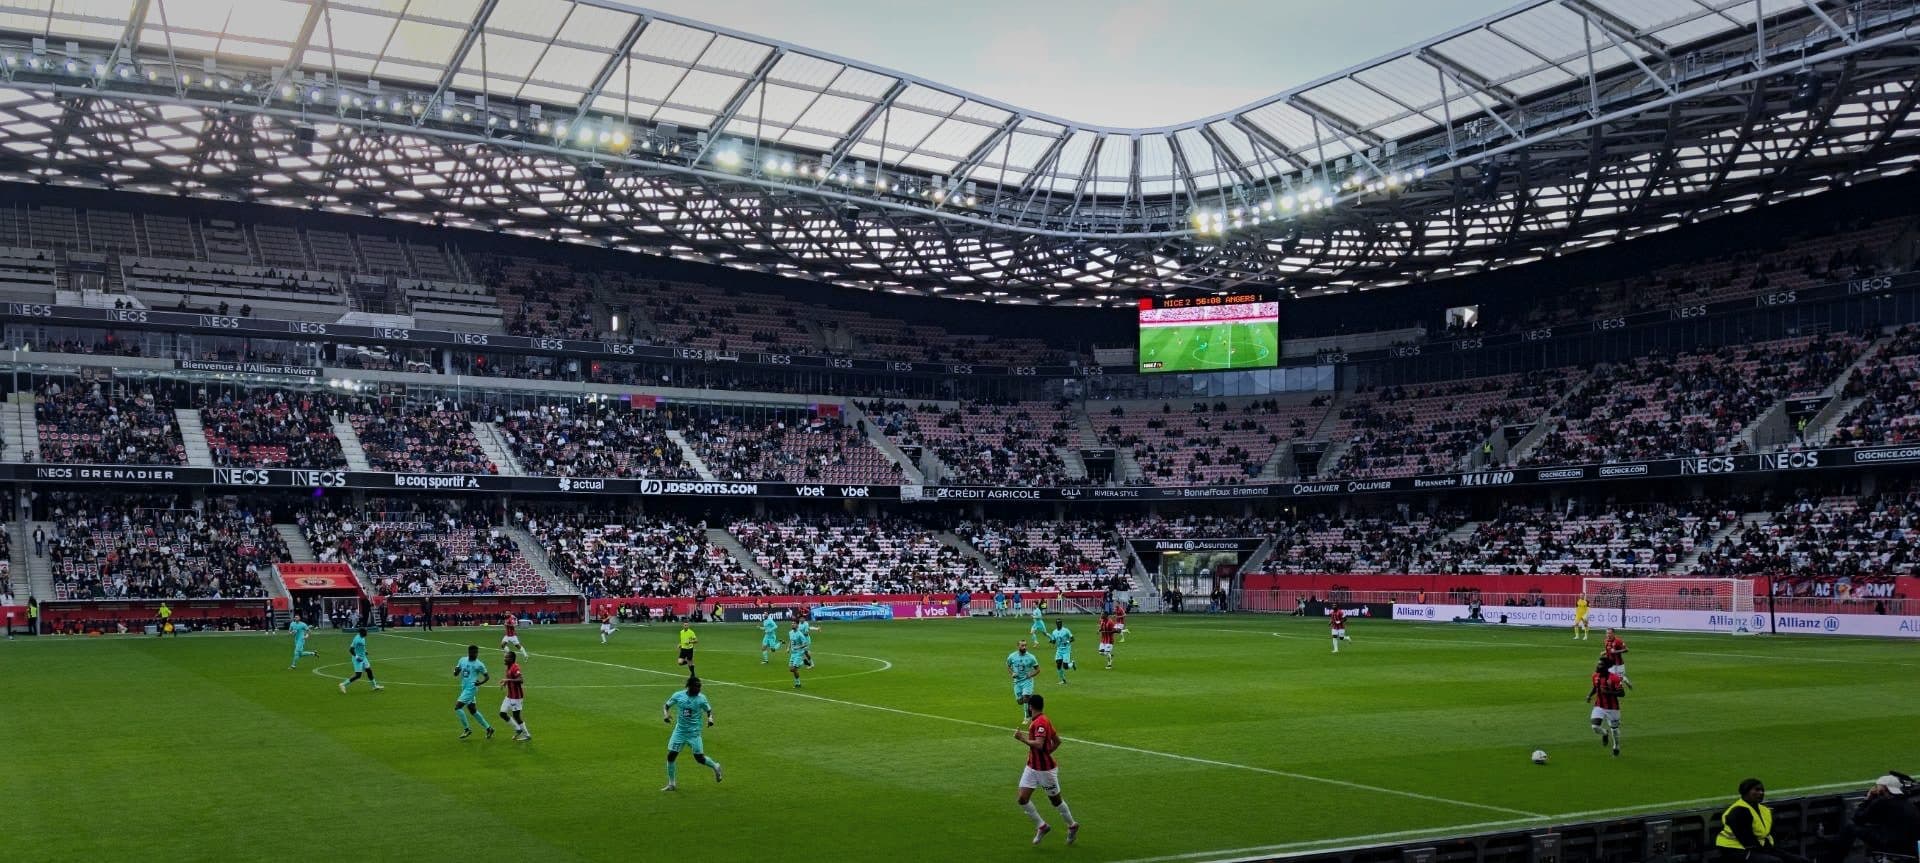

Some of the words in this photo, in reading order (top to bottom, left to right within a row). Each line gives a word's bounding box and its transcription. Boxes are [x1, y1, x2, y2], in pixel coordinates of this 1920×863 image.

[1849, 277, 1892, 294] INEOS
[1196, 297, 1221, 305] 56:08
[1225, 294, 1256, 303] ANGERS
[1756, 291, 1796, 307] INEOS
[9, 303, 52, 317] INEOS
[106, 309, 147, 323] INEOS
[1670, 305, 1706, 320] INEOS
[200, 315, 239, 329] INEOS
[288, 321, 326, 335] INEOS
[373, 327, 409, 340] INEOS
[454, 333, 488, 345] INEOS
[530, 337, 563, 350] INEOS
[603, 343, 635, 355] INEOS
[673, 348, 703, 360] INEOS
[182, 360, 233, 372] Bienvenue
[235, 362, 241, 371] à
[243, 362, 282, 374] l'Allianz
[284, 366, 317, 375] Riviera
[825, 357, 853, 369] INEOS
[886, 361, 913, 372] INEOS
[945, 363, 973, 375] INEOS
[1007, 366, 1037, 376] INEOS
[1073, 366, 1104, 376] INEOS
[1857, 449, 1920, 460] OGCNICE.COM
[1681, 457, 1735, 475] INEOS
[1760, 452, 1818, 470] INEOS
[37, 468, 73, 478] INEOS
[80, 470, 174, 480] GRENADIER
[213, 468, 270, 485] INEOS
[1602, 466, 1645, 475] OGCNICE.COM
[292, 471, 346, 487] INEOS
[395, 473, 405, 485] le
[406, 476, 428, 488] coq
[429, 475, 465, 488] sportif
[572, 479, 605, 490] actual
[1414, 477, 1456, 488] Brasserie
[1460, 471, 1514, 487] MAURO
[663, 483, 758, 495] JDSPORTS.COM
[796, 485, 825, 496] vbet
[840, 486, 869, 497] vbet
[948, 488, 985, 499] CRÉDIT
[987, 490, 1041, 499] AGRICOLE
[1061, 488, 1081, 496] CALA
[1184, 489, 1231, 497] Bonnaffoux
[762, 611, 783, 620] sortif
[924, 607, 949, 616] vbet
[1397, 608, 1424, 616] Allianz
[1608, 612, 1617, 623] la
[1709, 615, 1747, 626] Allianz
[1778, 617, 1820, 628] Allianz
